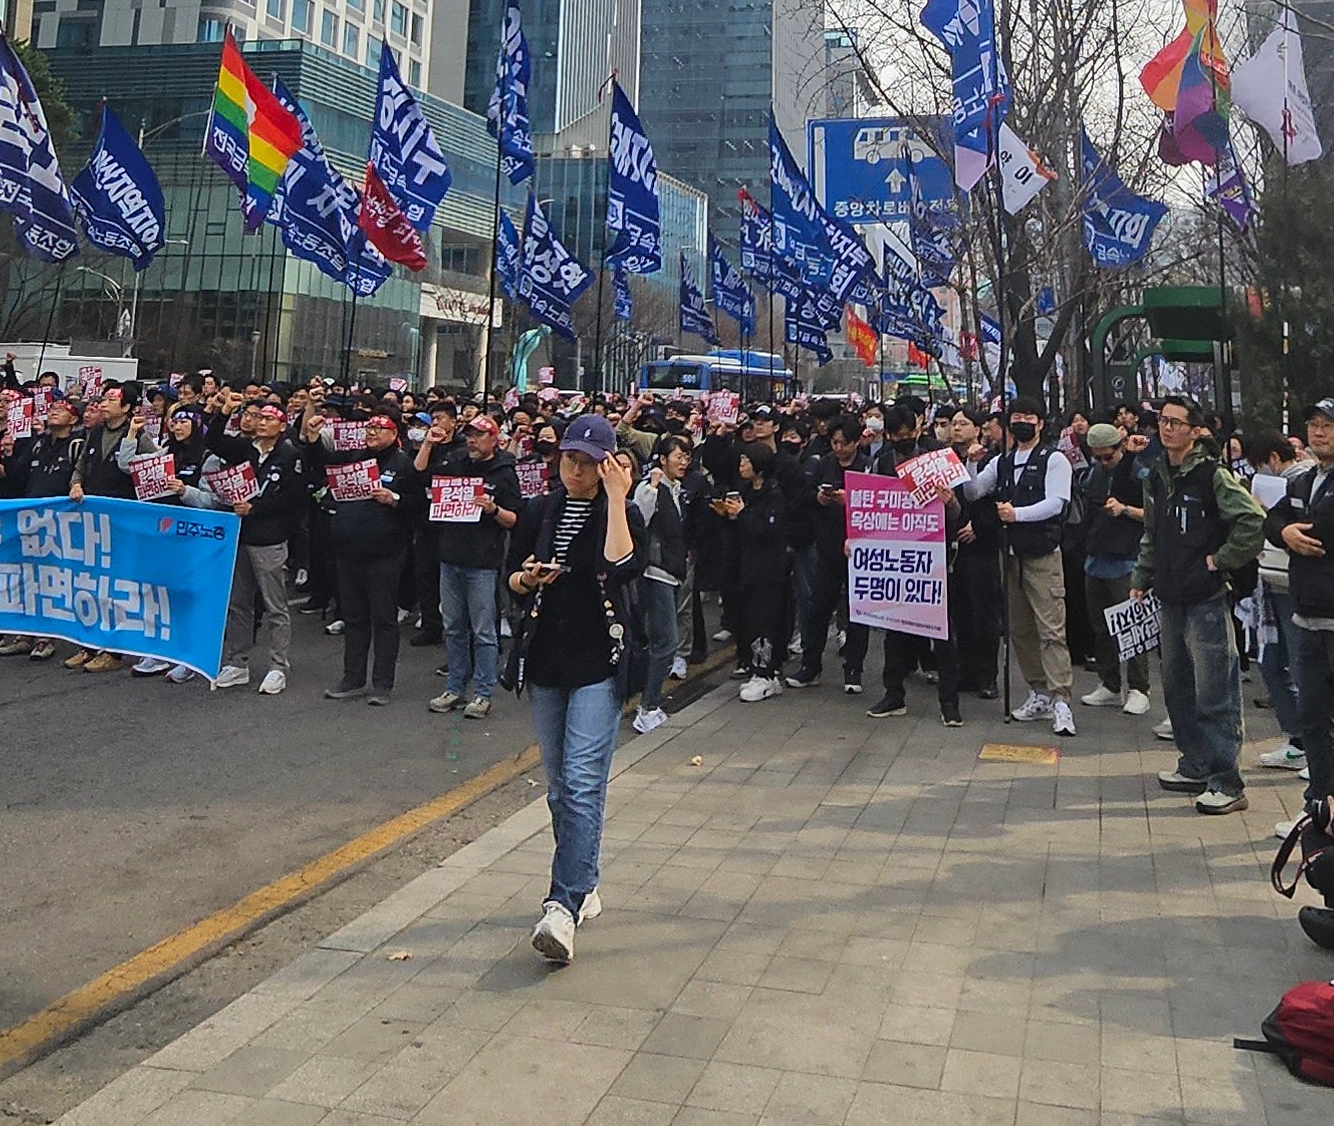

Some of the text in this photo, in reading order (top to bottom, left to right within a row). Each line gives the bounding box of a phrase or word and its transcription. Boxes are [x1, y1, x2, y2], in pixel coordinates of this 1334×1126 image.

[833, 199, 959, 218] 중앙차로버전용
[877, 489, 927, 510] 구미공
[175, 519, 228, 542] 민주노총
[850, 511, 940, 533] 옥상에는 아직도
[17, 509, 112, 569] 없다!
[853, 547, 933, 575] 여성노동자
[854, 576, 943, 605] 두명이 있다!
